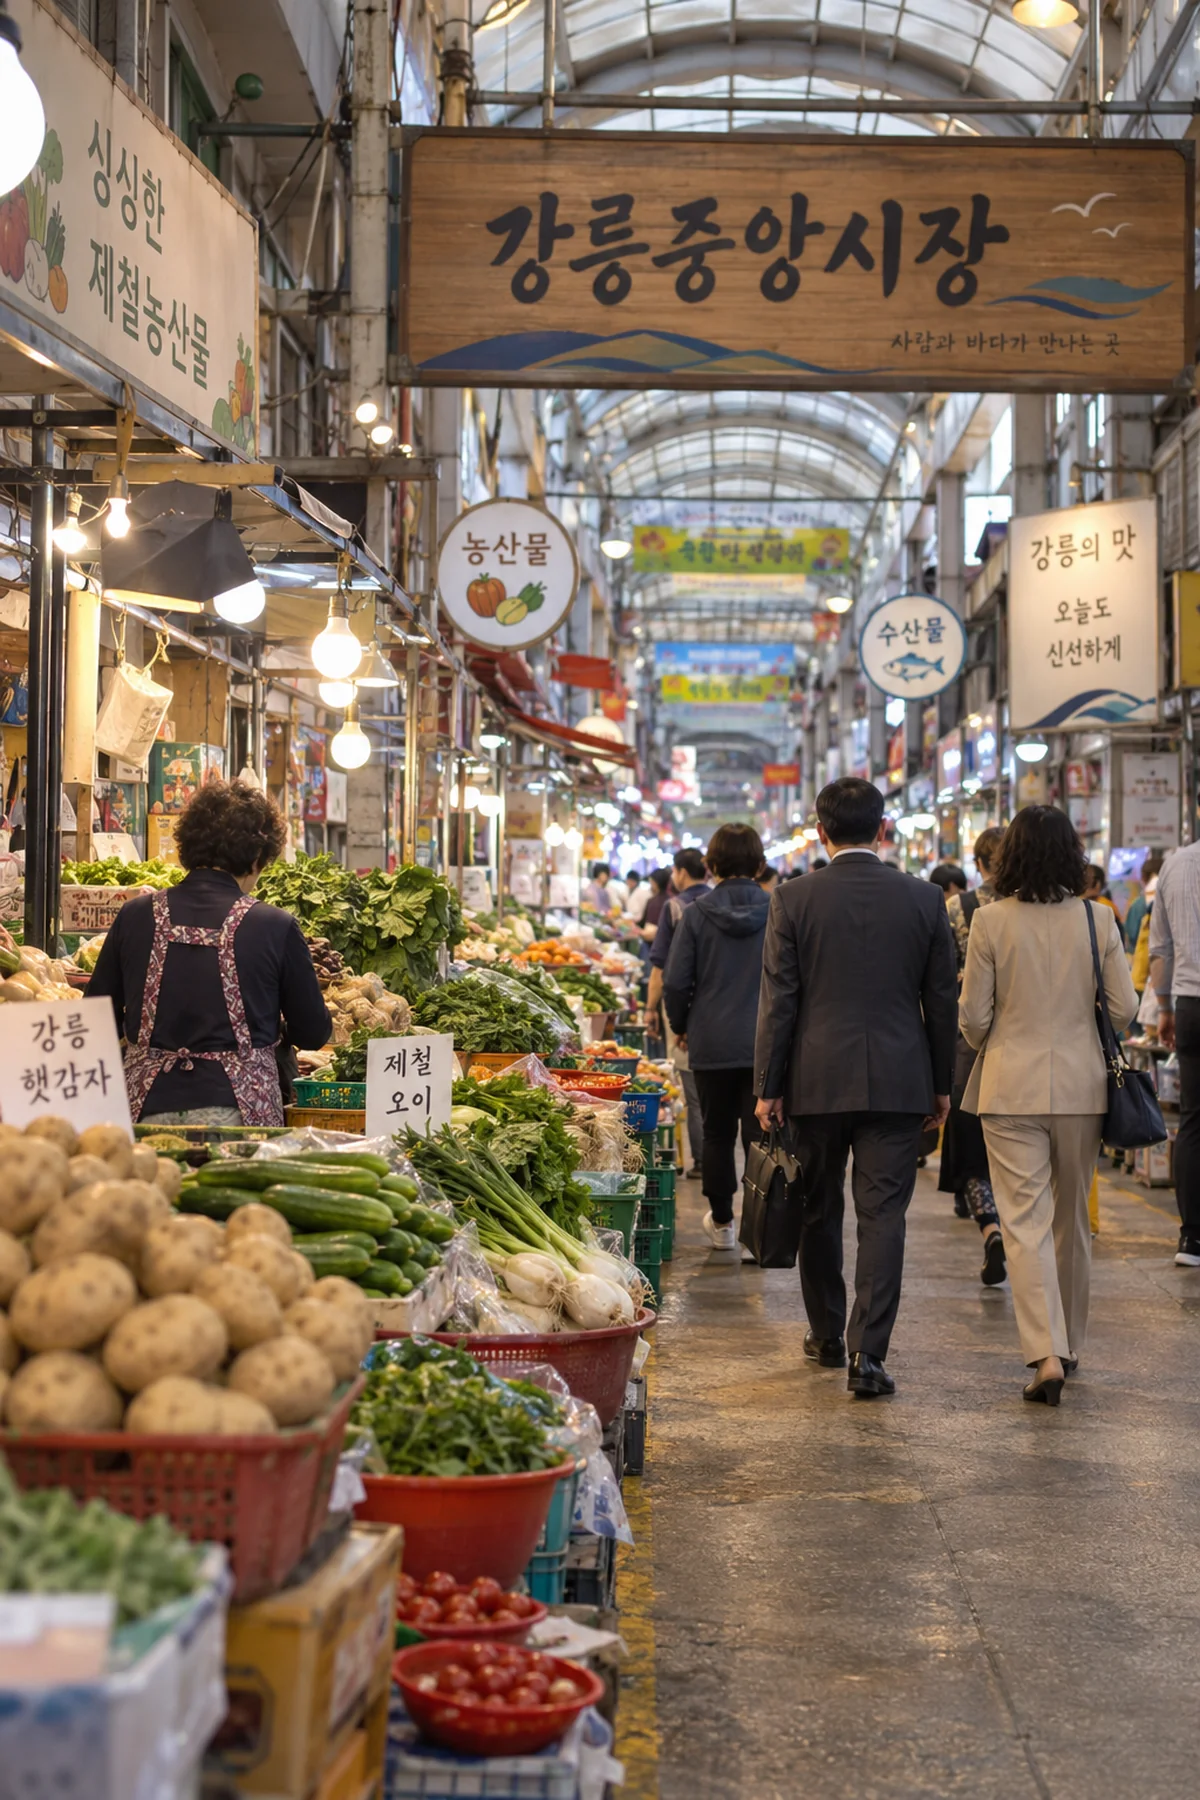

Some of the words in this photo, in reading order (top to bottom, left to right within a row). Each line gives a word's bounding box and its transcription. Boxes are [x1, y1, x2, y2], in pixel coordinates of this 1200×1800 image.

[88, 119, 165, 255] 싱싱한
[486, 191, 1010, 307] 강릉중앙시장
[88, 238, 210, 390] 제철농산물
[891, 331, 955, 353] 사람과
[966, 331, 1029, 353] 바다가
[1039, 332, 1094, 355] 만나는
[1104, 332, 1121, 356] 곳
[462, 532, 551, 566] 농산물
[1031, 532, 1099, 571] 강릉의
[1113, 524, 1137, 562] 맛
[1054, 597, 1112, 625] 오늘도
[878, 616, 946, 647] 수산물
[1046, 634, 1121, 668] 신선하게
[31, 1013, 90, 1053] 강릉
[383, 1045, 431, 1077] 제철
[20, 1059, 111, 1105] 햇감자
[385, 1086, 431, 1117] 오이
